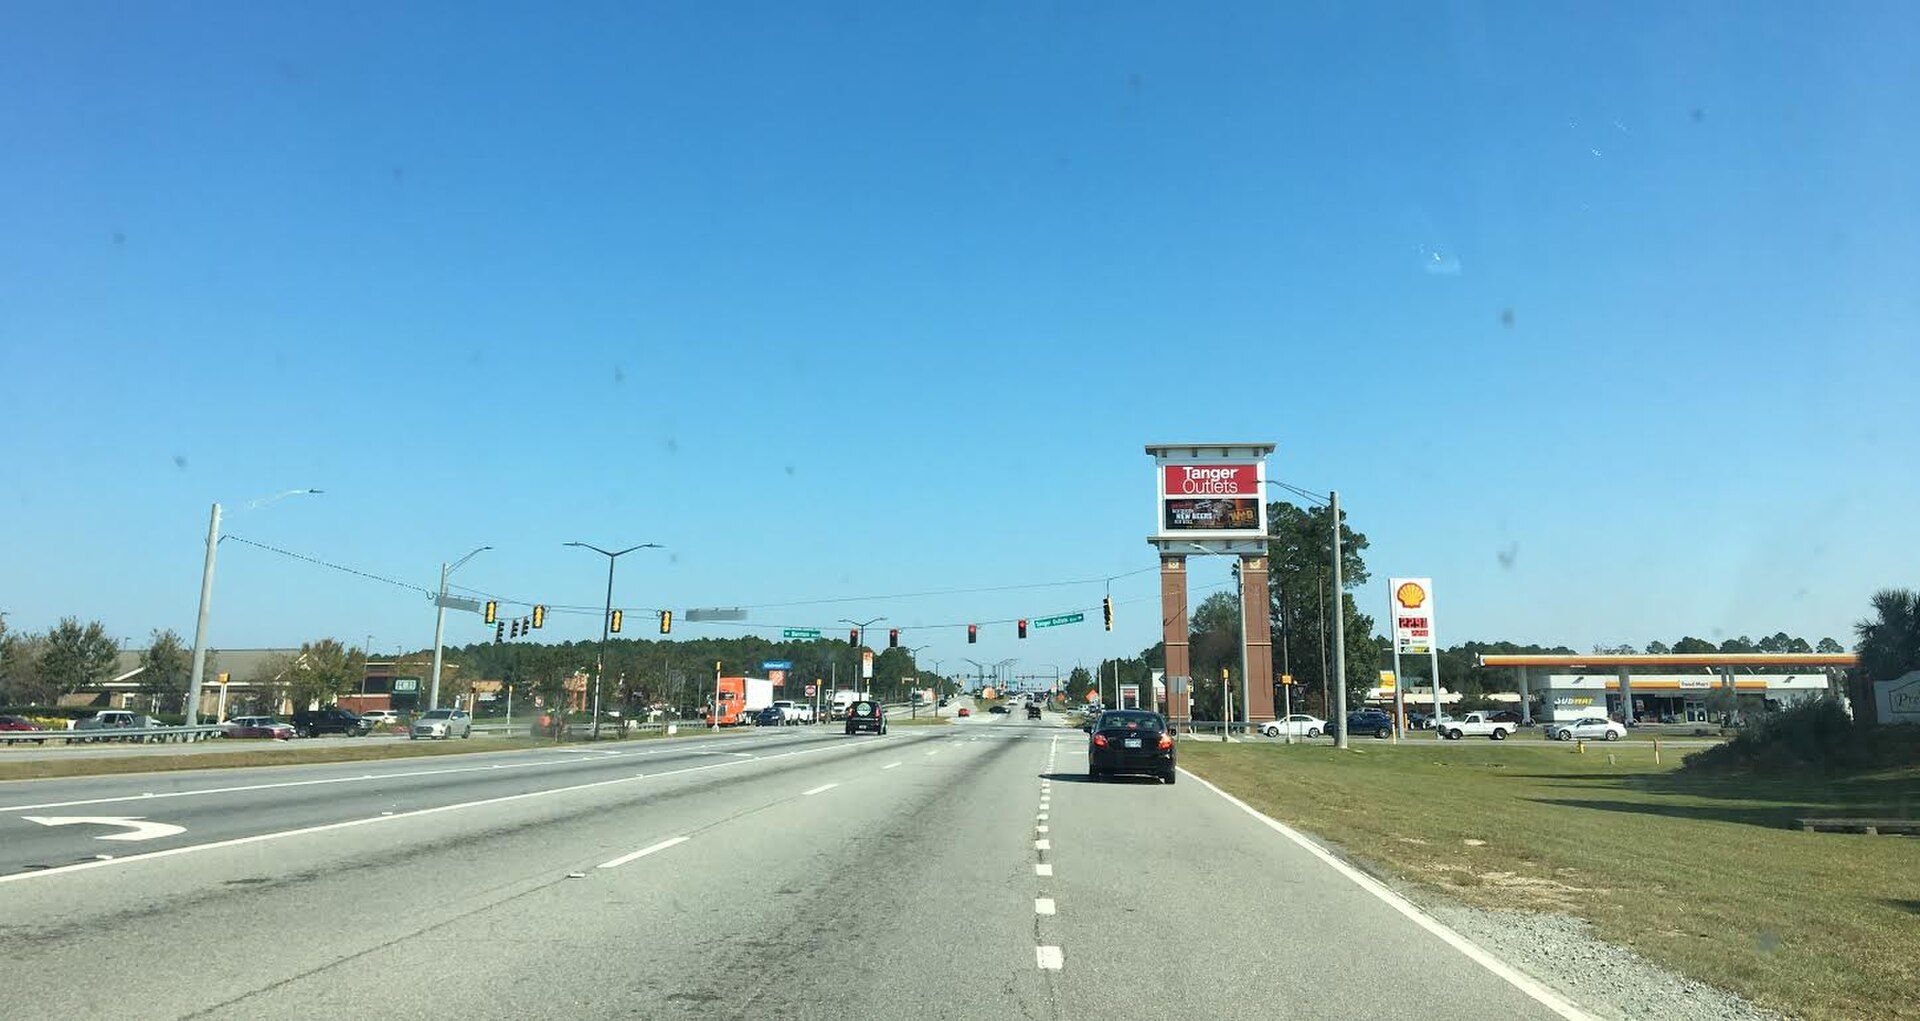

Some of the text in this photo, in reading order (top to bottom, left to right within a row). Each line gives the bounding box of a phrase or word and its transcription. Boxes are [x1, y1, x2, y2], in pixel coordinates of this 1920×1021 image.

[1182, 466, 1239, 482] Tanger
[1182, 478, 1238, 494] Outlets
[1554, 697, 1593, 706] SUBWAY
